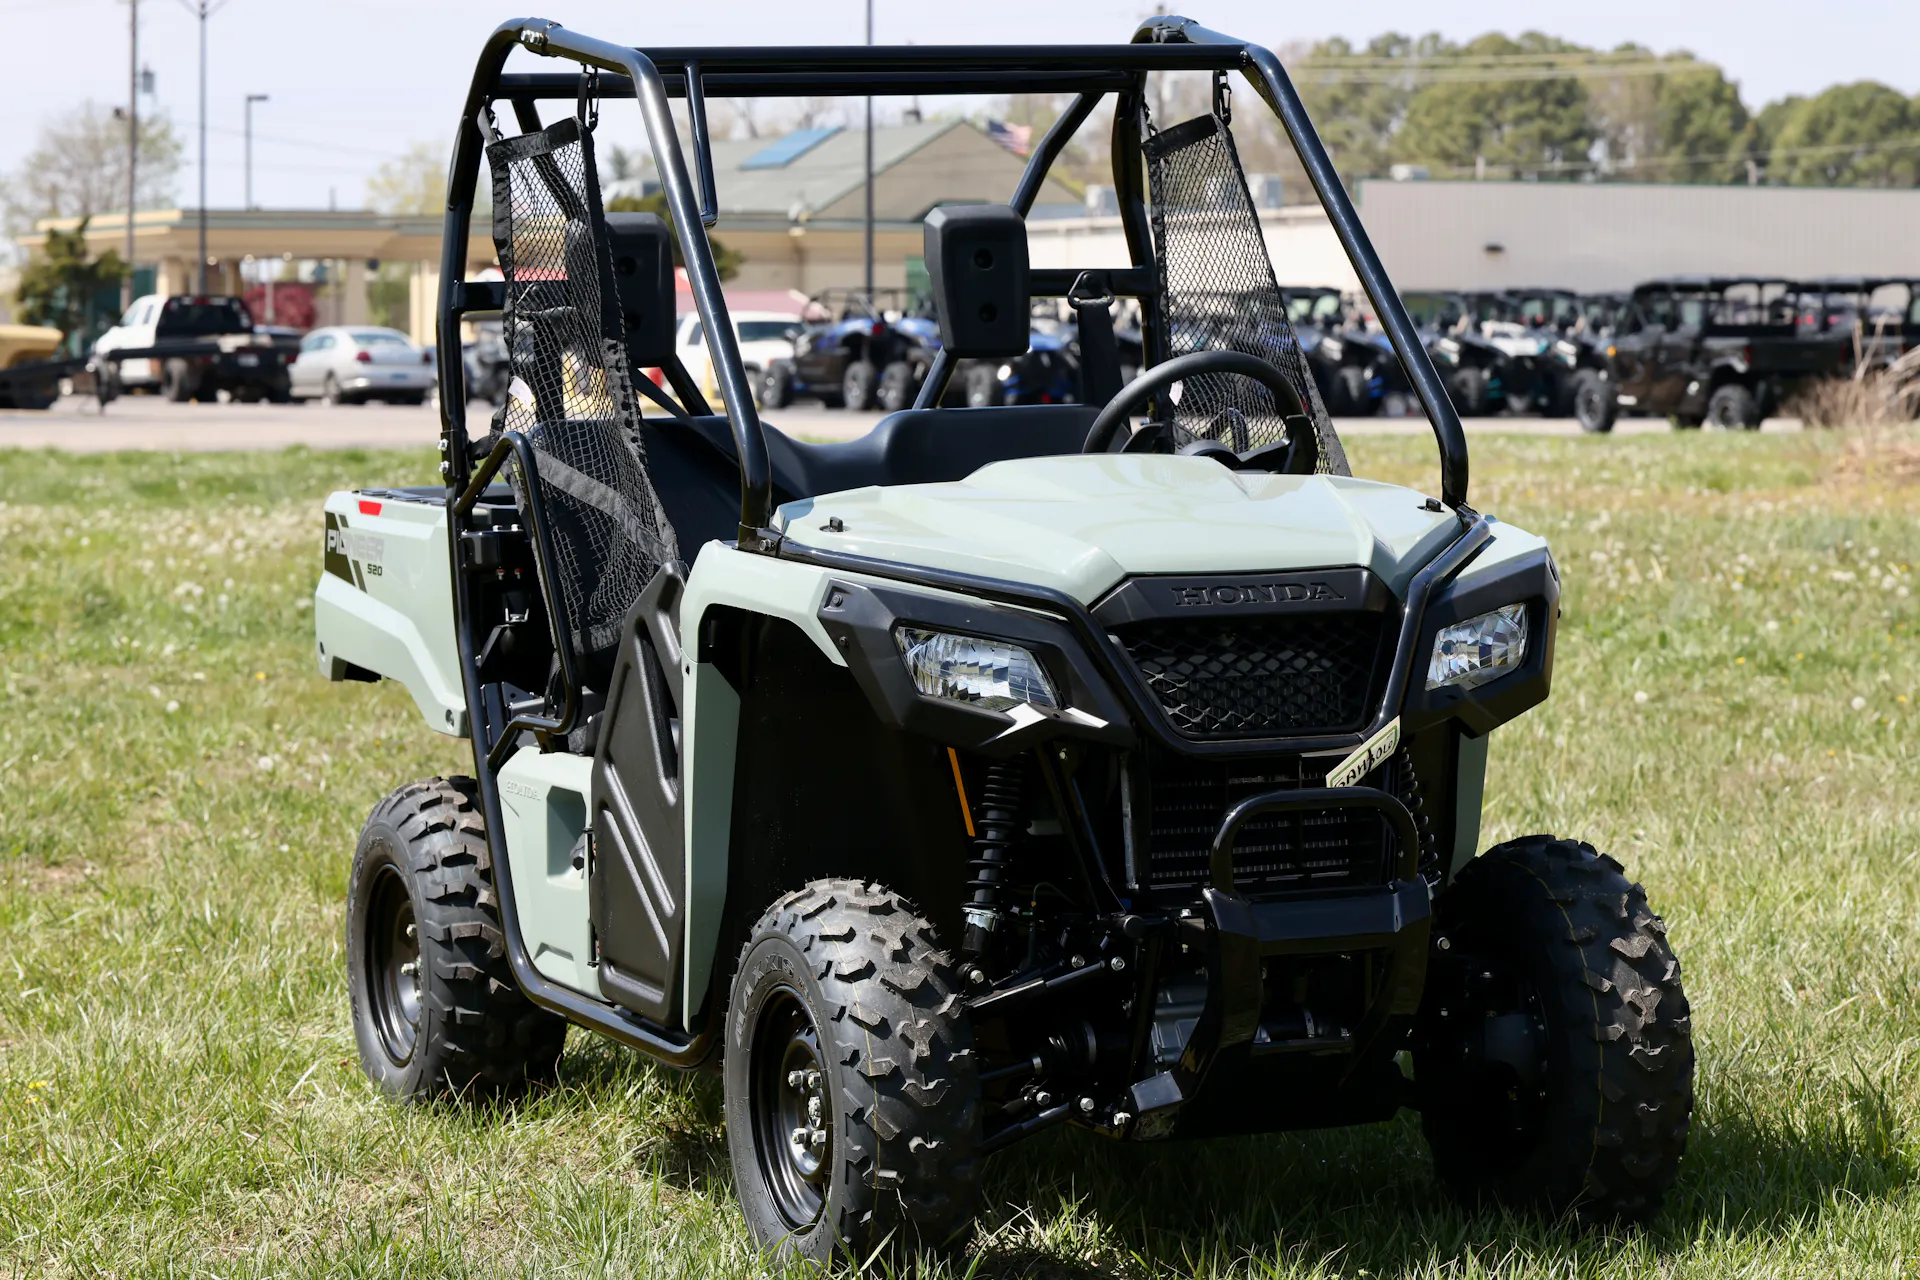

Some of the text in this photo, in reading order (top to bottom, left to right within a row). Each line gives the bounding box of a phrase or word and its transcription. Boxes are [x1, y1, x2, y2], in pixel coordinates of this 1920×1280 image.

[326, 529, 385, 562] PIONEER
[367, 563, 383, 577] 520
[1170, 582, 1347, 606] HONDA
[735, 953, 795, 1049] MAXXIS
